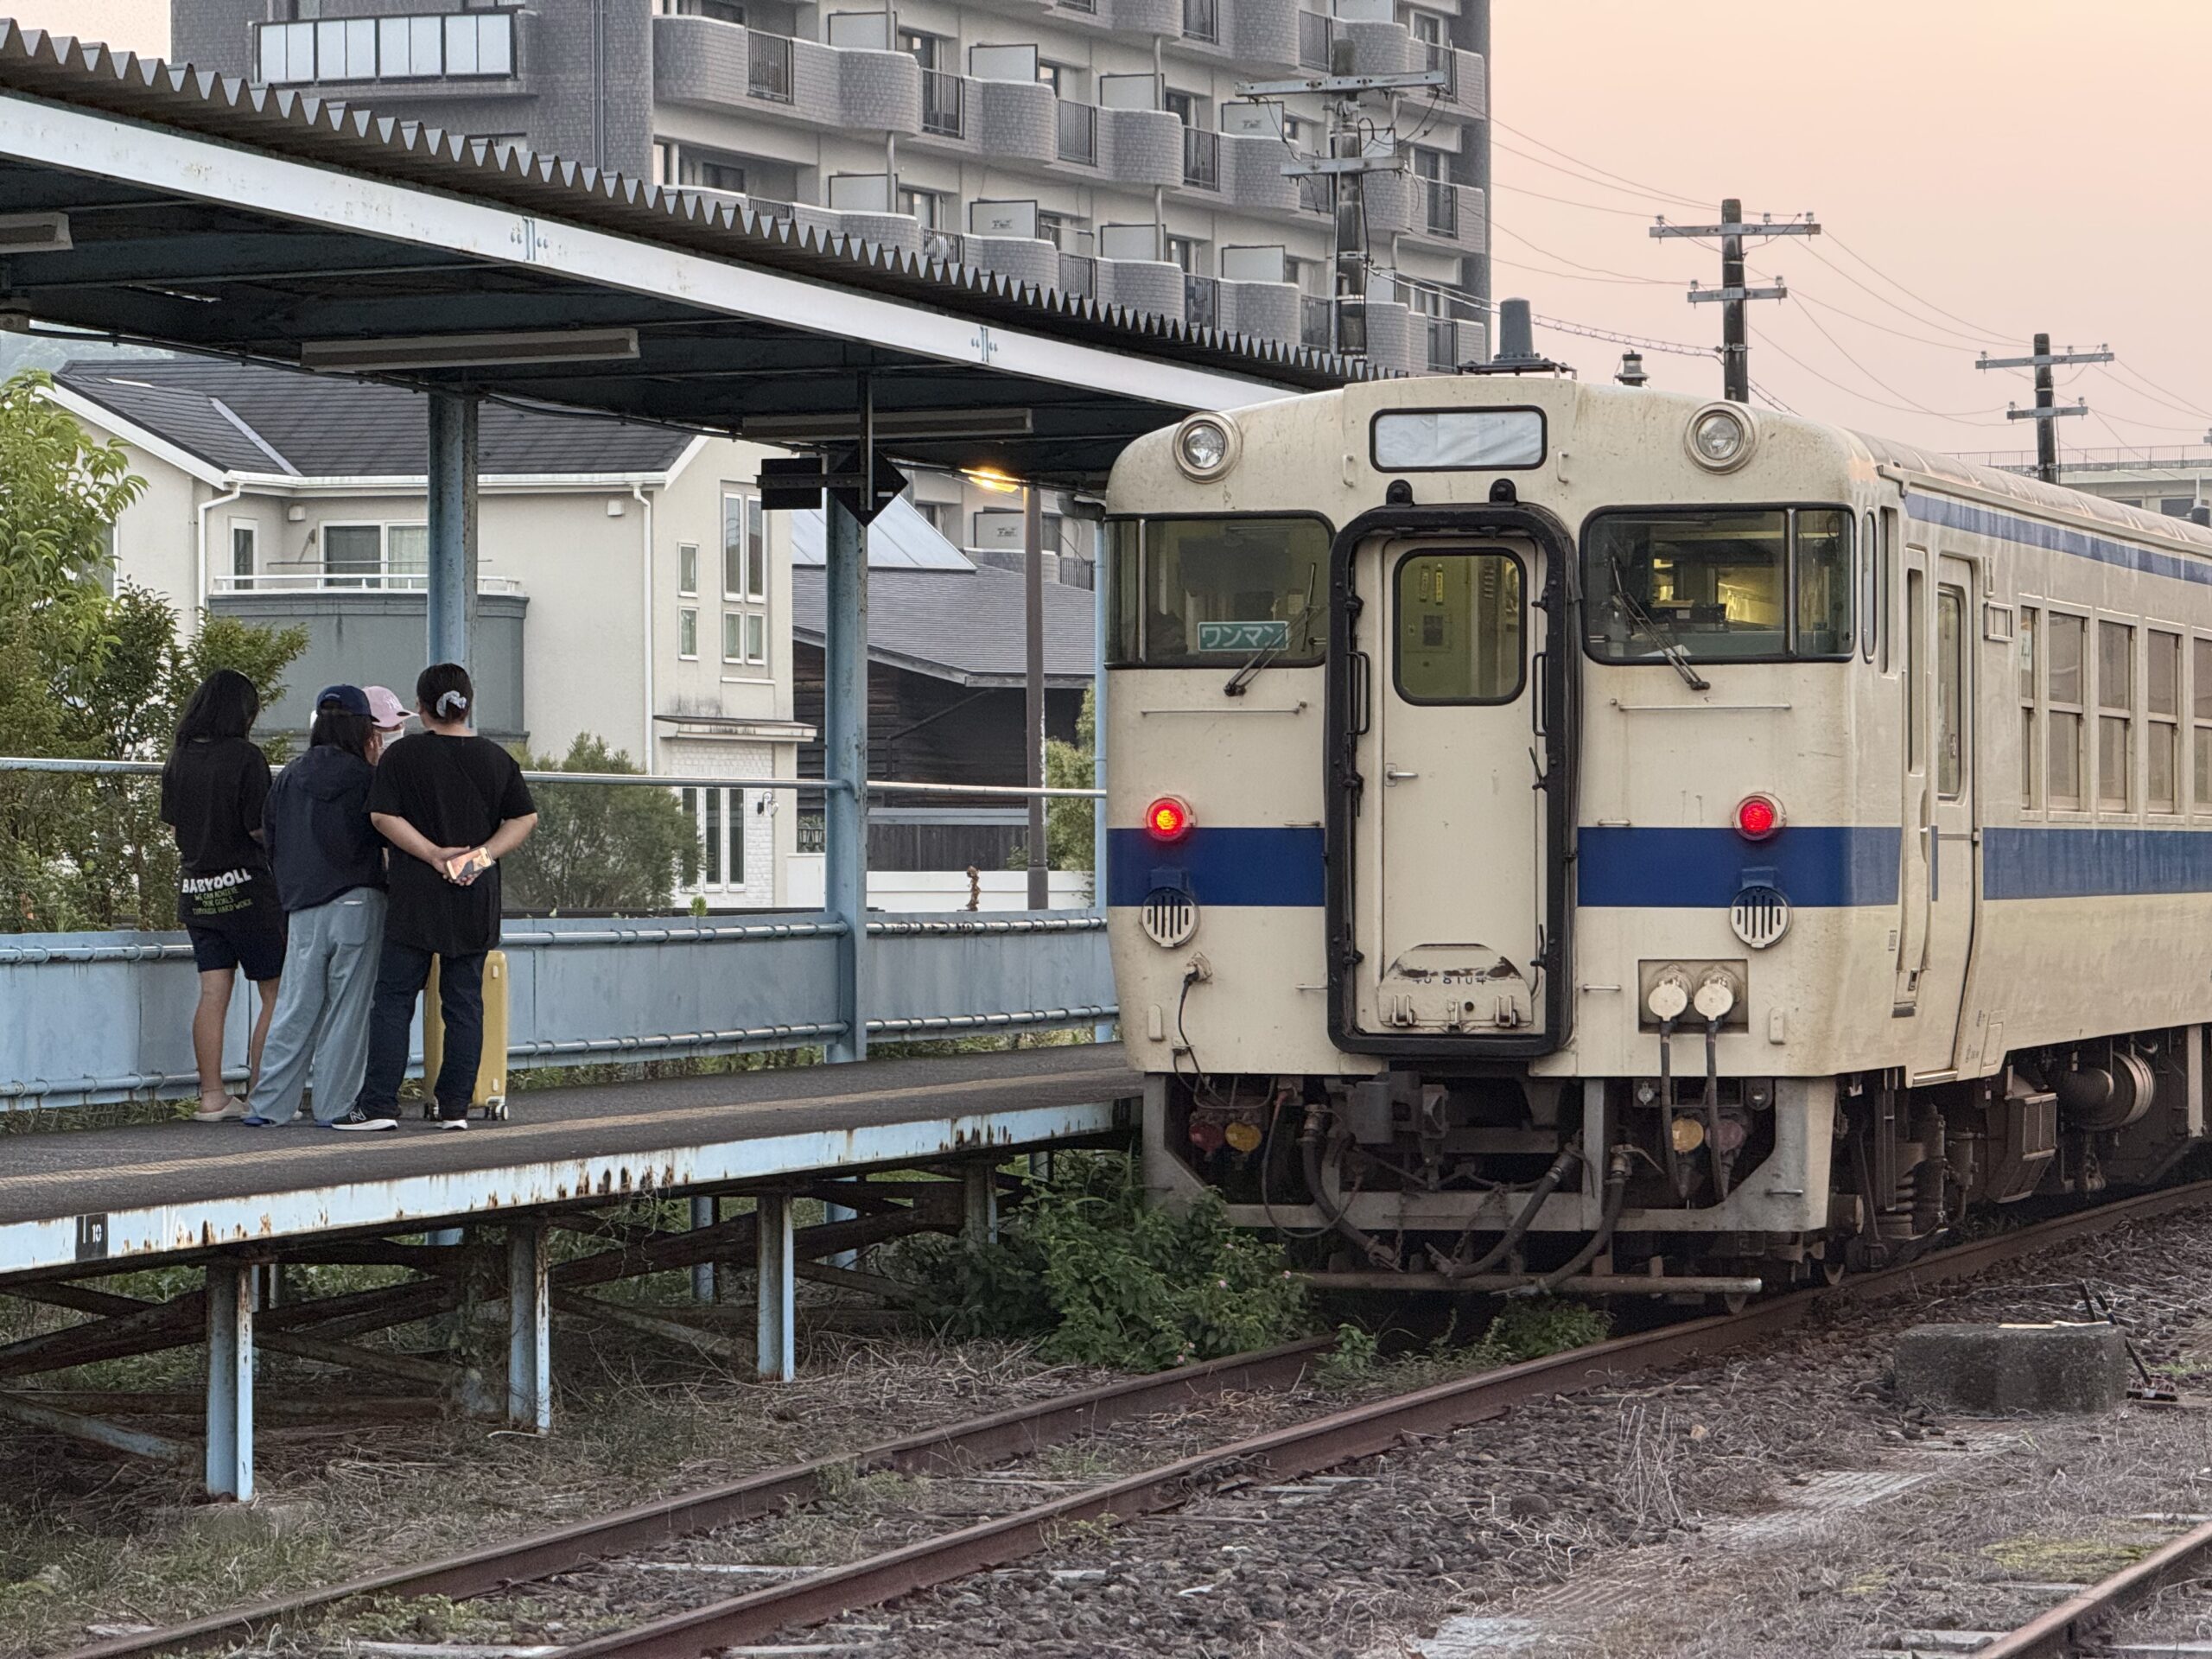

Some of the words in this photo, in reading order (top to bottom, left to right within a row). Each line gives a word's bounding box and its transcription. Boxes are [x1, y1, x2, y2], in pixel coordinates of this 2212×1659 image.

[1201, 626, 1284, 648] ワンマン
[181, 868, 252, 893] BABYDOLL
[194, 893, 204, 901] WE
[203, 892, 214, 900] CAN
[215, 896, 234, 906] GOALS
[218, 904, 234, 913] HARD
[234, 899, 253, 910] WORK
[92, 1224, 102, 1243] 10
